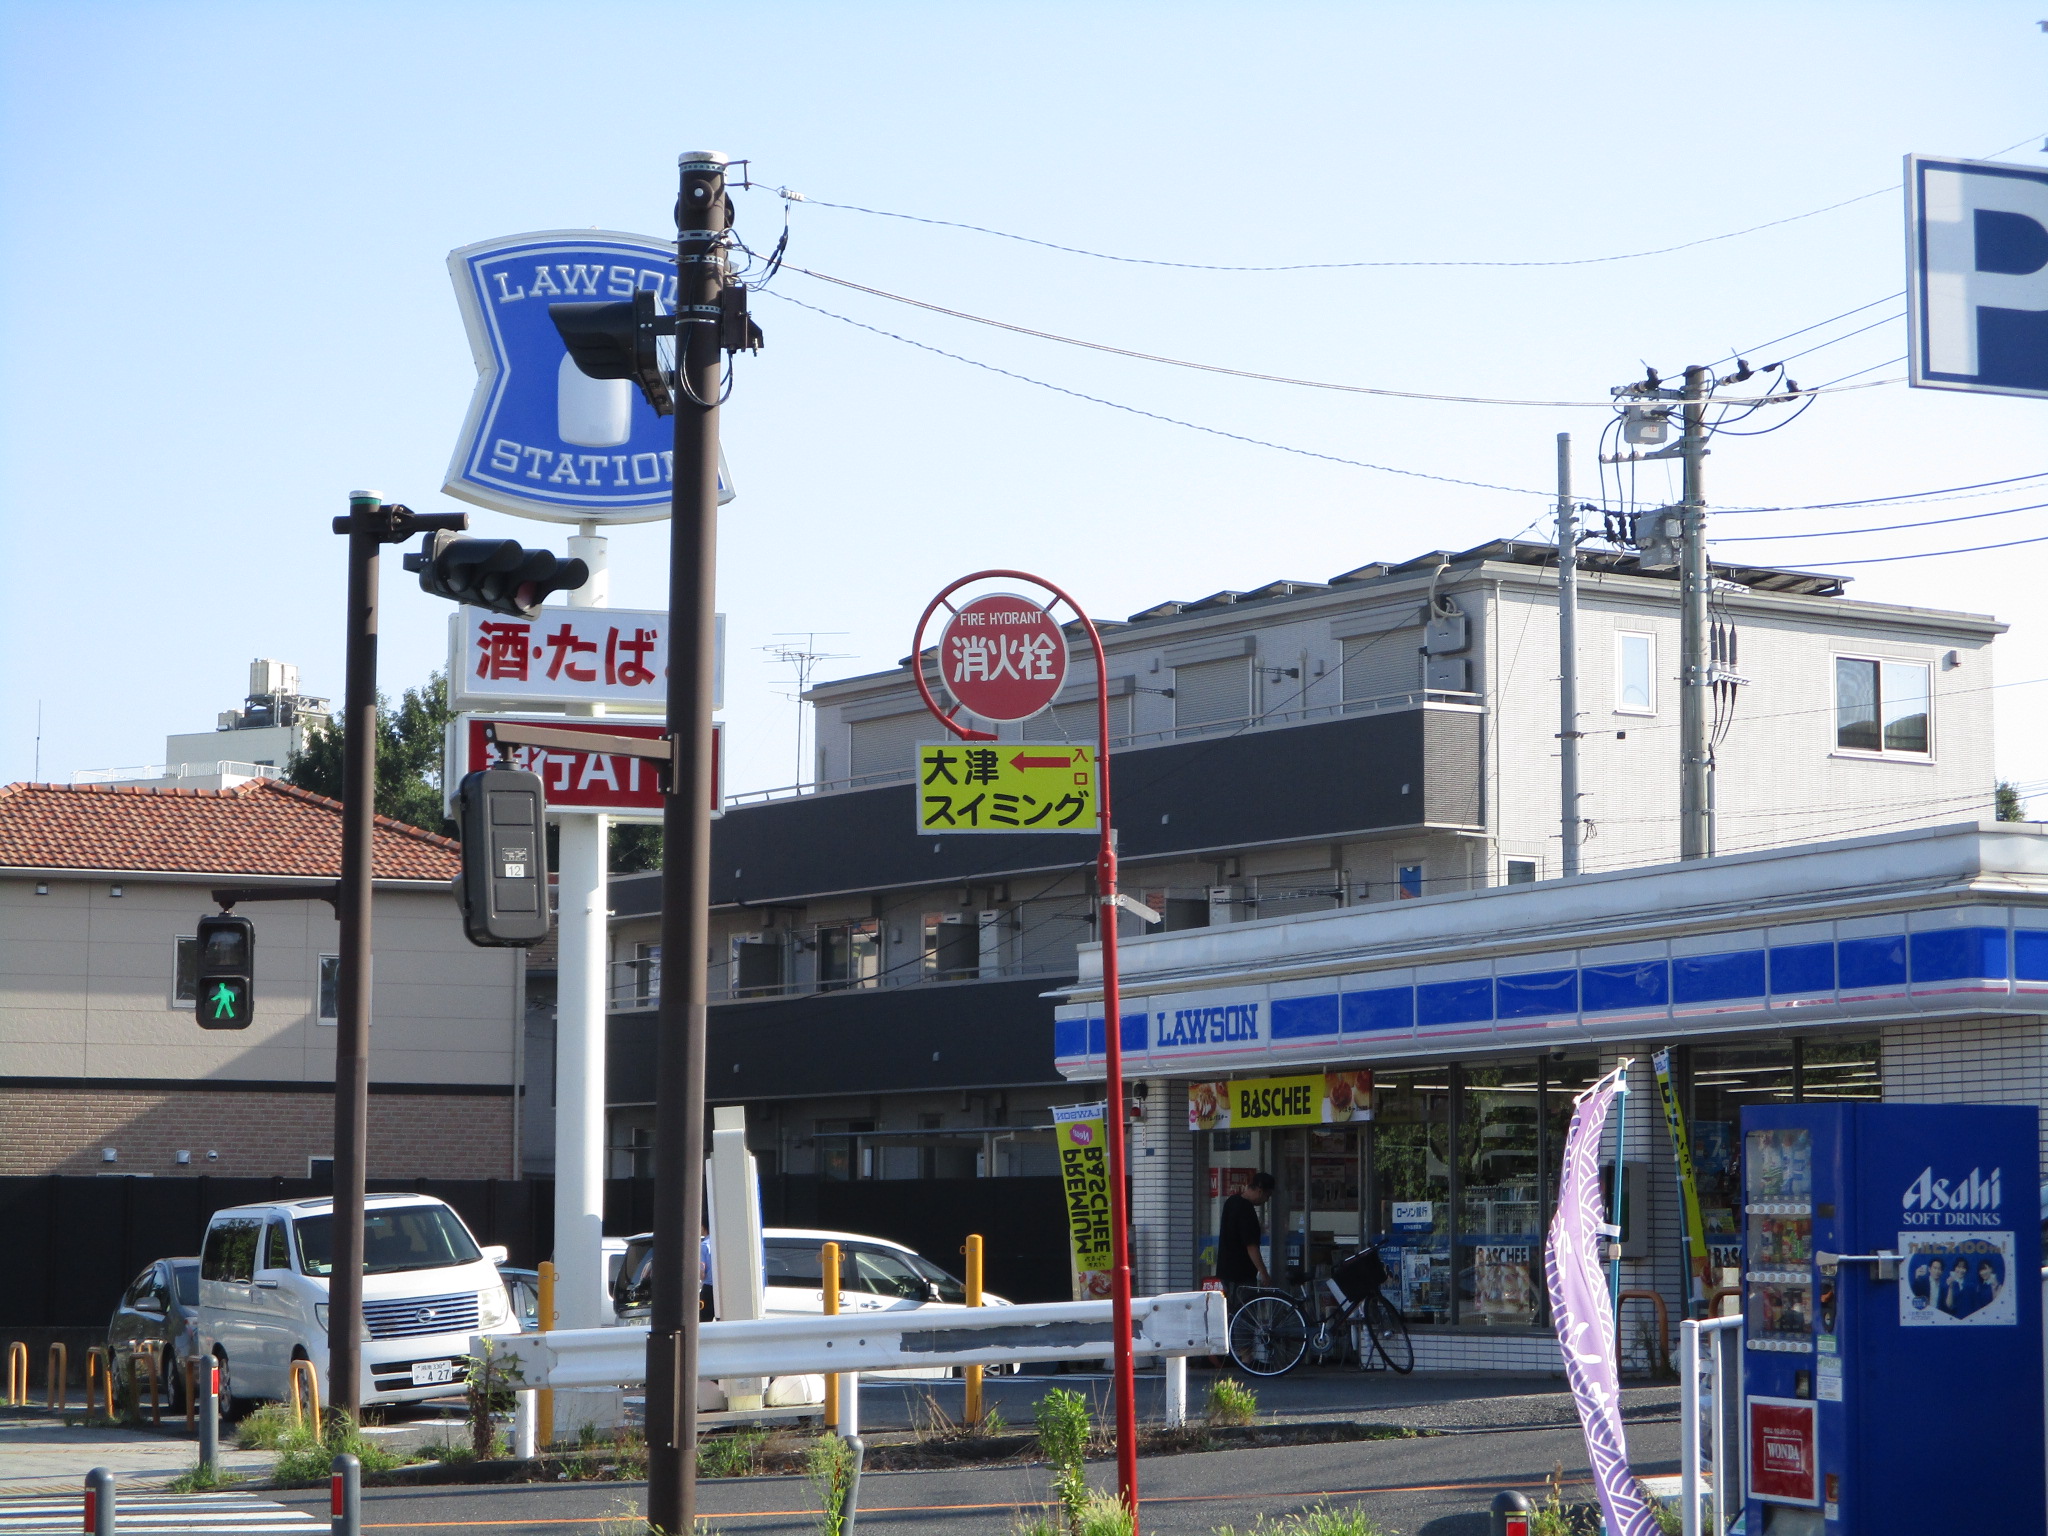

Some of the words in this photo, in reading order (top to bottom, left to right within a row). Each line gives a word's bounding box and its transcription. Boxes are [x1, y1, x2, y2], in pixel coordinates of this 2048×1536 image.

[1924, 169, 2048, 377] P
[960, 612, 986, 626] FIRE
[990, 611, 1043, 625] HYDRANT
[476, 619, 669, 687] 酒・たば
[952, 632, 1057, 683] 消火栓
[923, 748, 1000, 786] 大津
[924, 789, 1090, 827] スイミング
[508, 865, 522, 877] 12
[1156, 1003, 1259, 1048] LAWSON
[1902, 1166, 2001, 1210] Asahi
[1396, 1206, 1428, 1219] ローソン銀行
[1903, 1212, 1941, 1226] SOFT
[1944, 1212, 2001, 1226] DRINKS
[1767, 1442, 1800, 1460] WONDA
